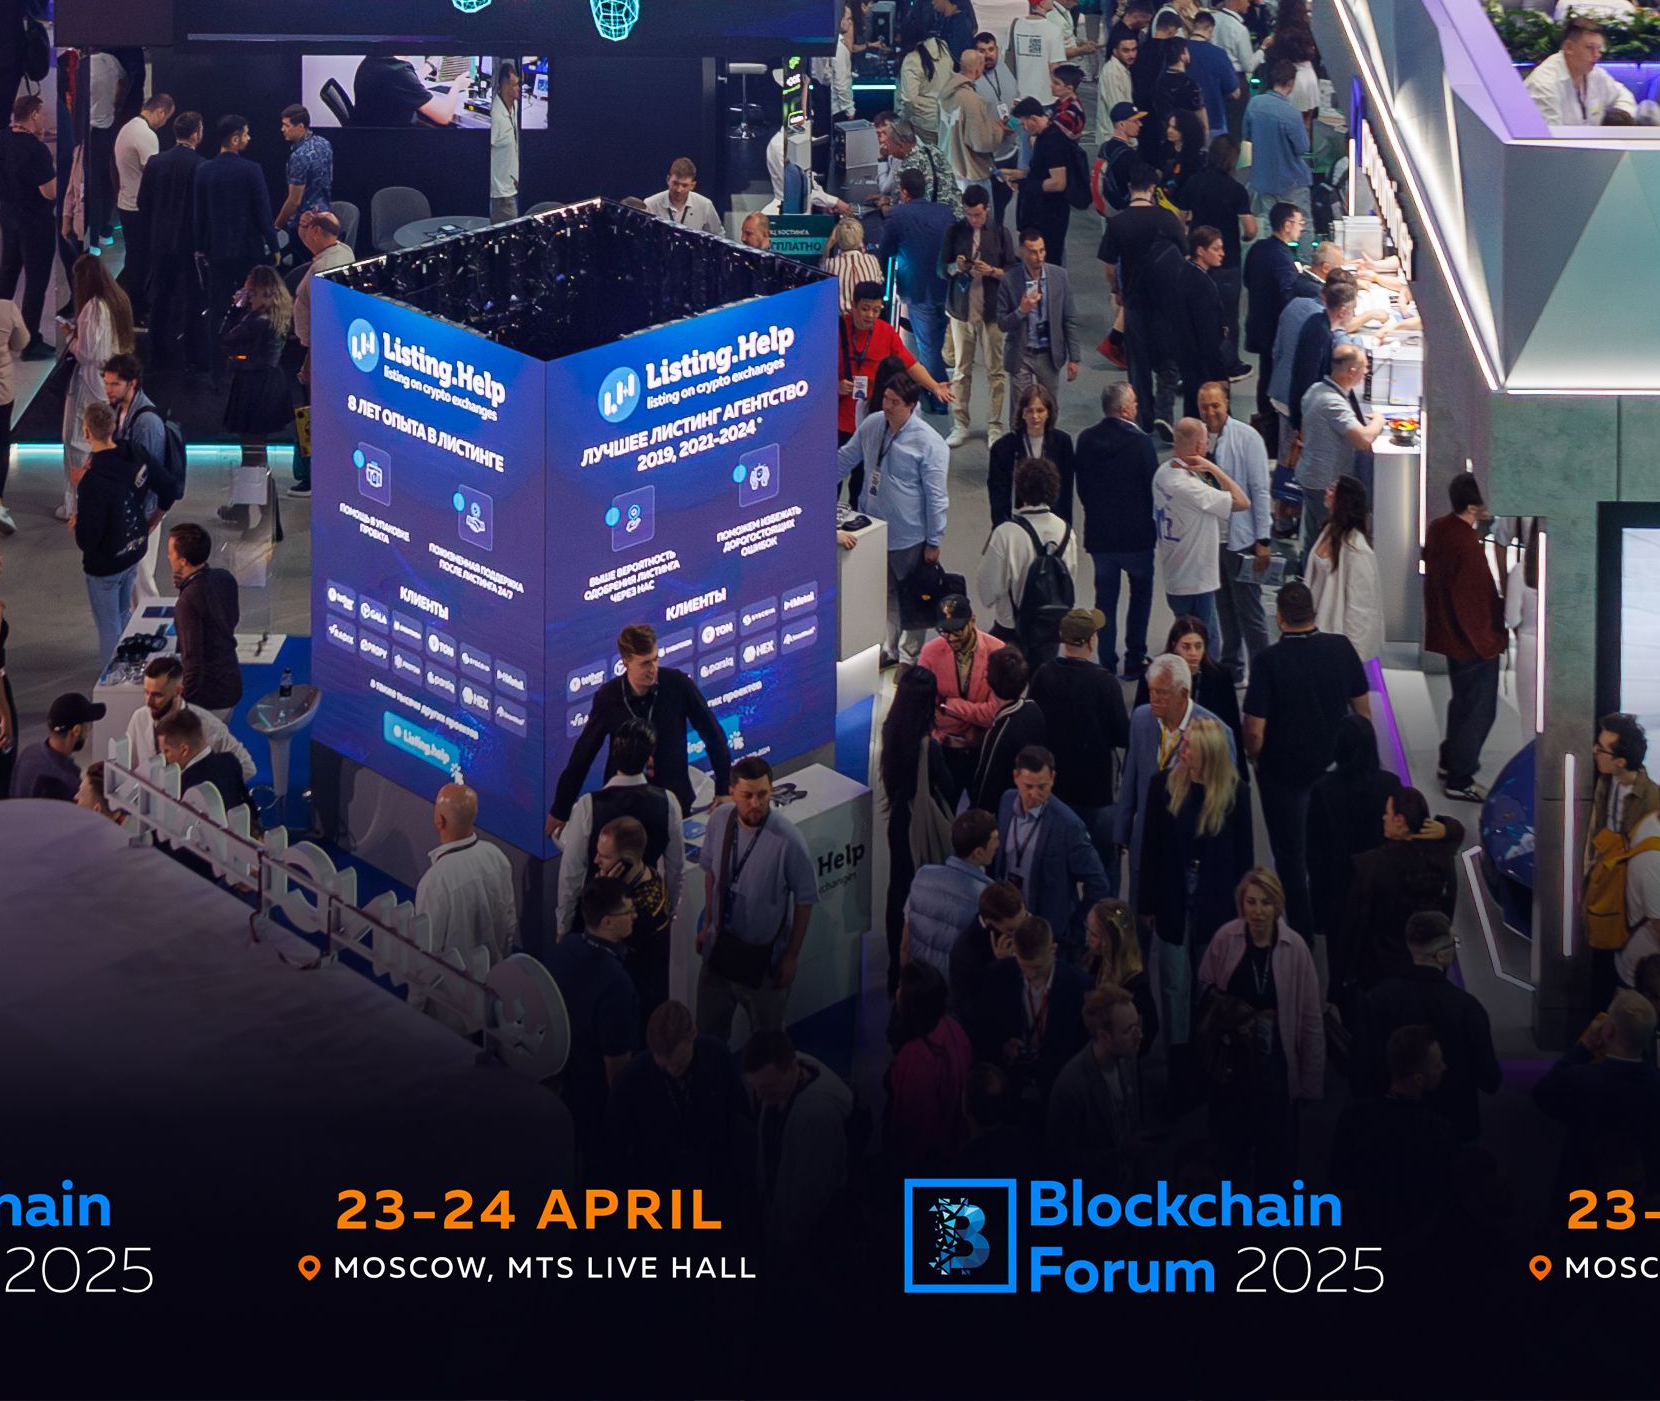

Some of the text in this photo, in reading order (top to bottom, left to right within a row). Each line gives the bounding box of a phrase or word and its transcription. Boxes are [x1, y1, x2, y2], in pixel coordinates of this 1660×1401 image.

[771, 241, 822, 251] СПЛАТНО
[382, 332, 506, 408] Listing.Help
[646, 325, 795, 390] Listing.Help
[383, 365, 498, 421] listing on crypto exchanges
[647, 358, 786, 409] listing on crypto exchanges
[357, 398, 382, 421] ЛЕТ
[382, 409, 427, 441] ОПЫТА
[427, 426, 438, 444] В
[437, 431, 505, 473] ЛИСТИНГЕ
[581, 380, 809, 468] ЛУЧШЕЕ ЛИСТИНГ АГЕНТСТВО
[636, 446, 677, 472] 2019,
[740, 536, 778, 557] ОШИБОК
[439, 558, 463, 579] ПОСЛЕ
[584, 560, 680, 601] ОДОБРЕНИЯ ЛИСТИНГА
[617, 549, 677, 579] ВЕРОЯТНОСТЬ
[399, 585, 449, 621] КЛИЕНТЫ
[610, 580, 655, 603] ЧЕРЕЗ НАС
[666, 587, 727, 621] КЛИЕНТЫ
[715, 622, 734, 636] TON
[756, 640, 775, 656] HEX
[473, 693, 490, 711] HEX
[817, 843, 865, 877] Help
